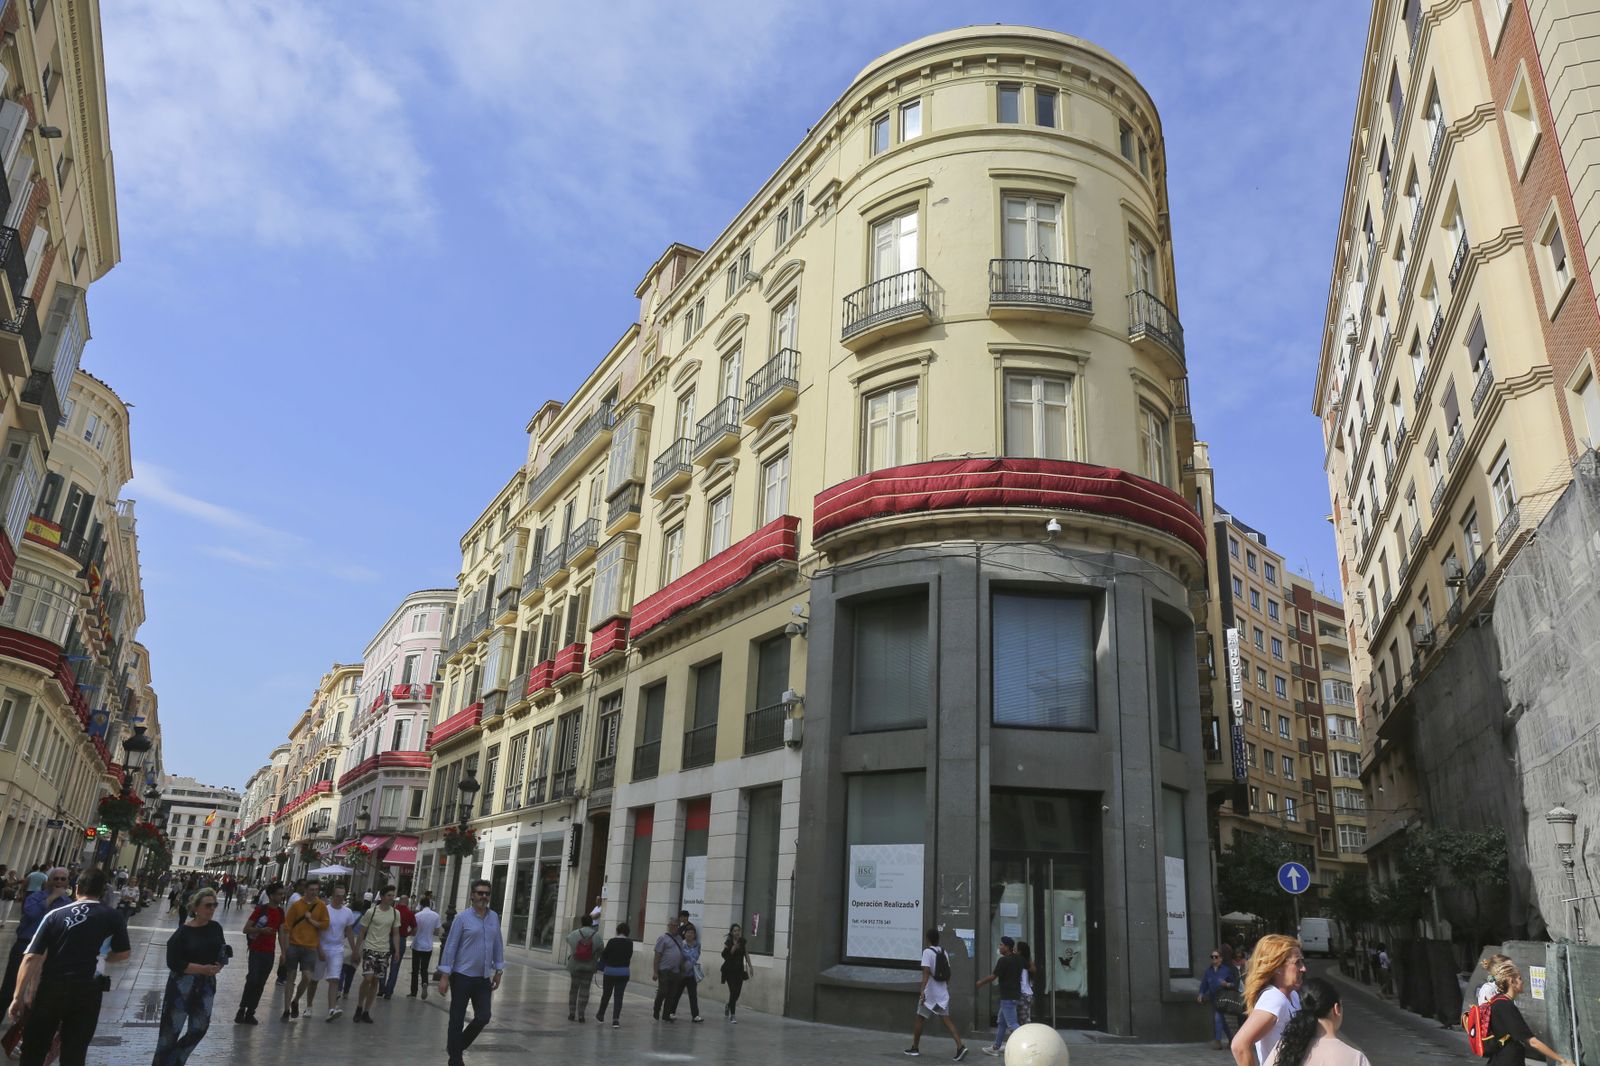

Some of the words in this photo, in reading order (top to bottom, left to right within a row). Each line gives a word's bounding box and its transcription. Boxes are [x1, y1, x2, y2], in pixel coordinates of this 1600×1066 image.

[1230, 648, 1240, 692] HOTEL
[1233, 700, 1243, 726] DON
[851, 900, 882, 908] Operación
